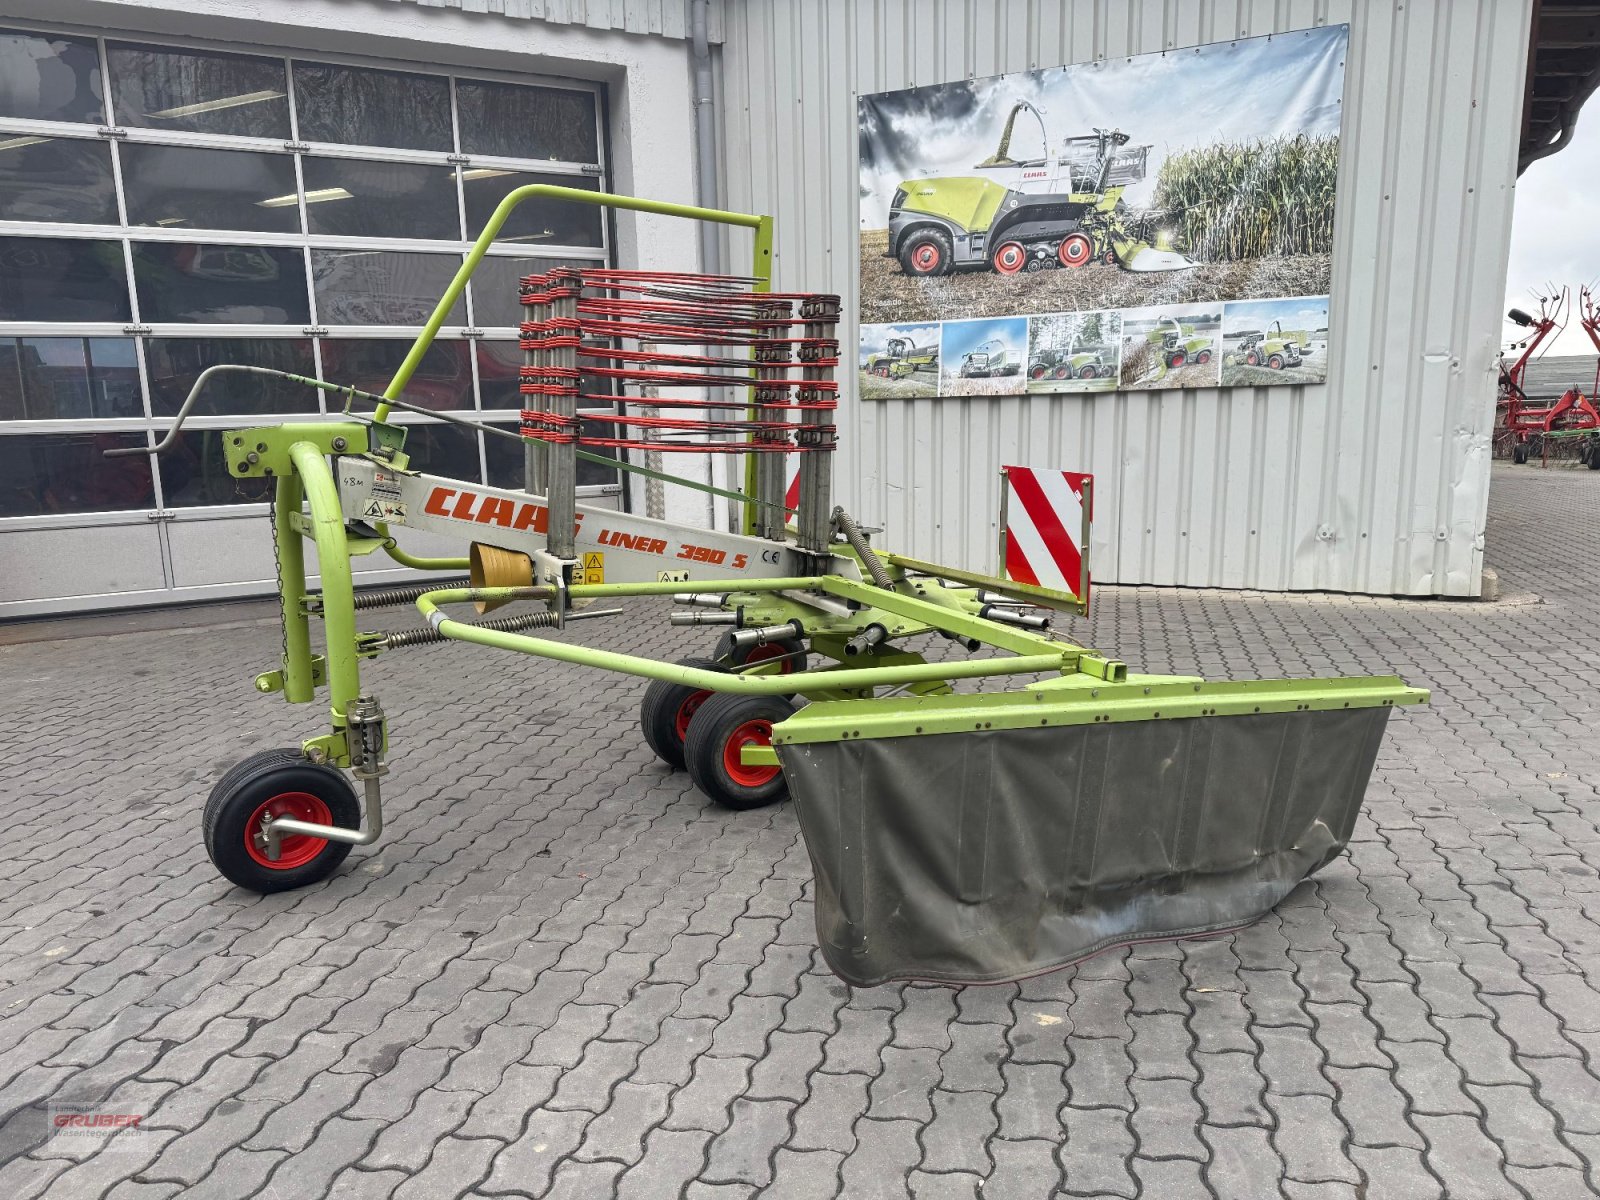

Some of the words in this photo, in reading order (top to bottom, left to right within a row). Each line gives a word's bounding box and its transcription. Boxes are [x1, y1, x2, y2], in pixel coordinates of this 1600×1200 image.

[597, 529, 668, 555] LINER
[676, 543, 727, 566] 390
[731, 553, 749, 569] S
